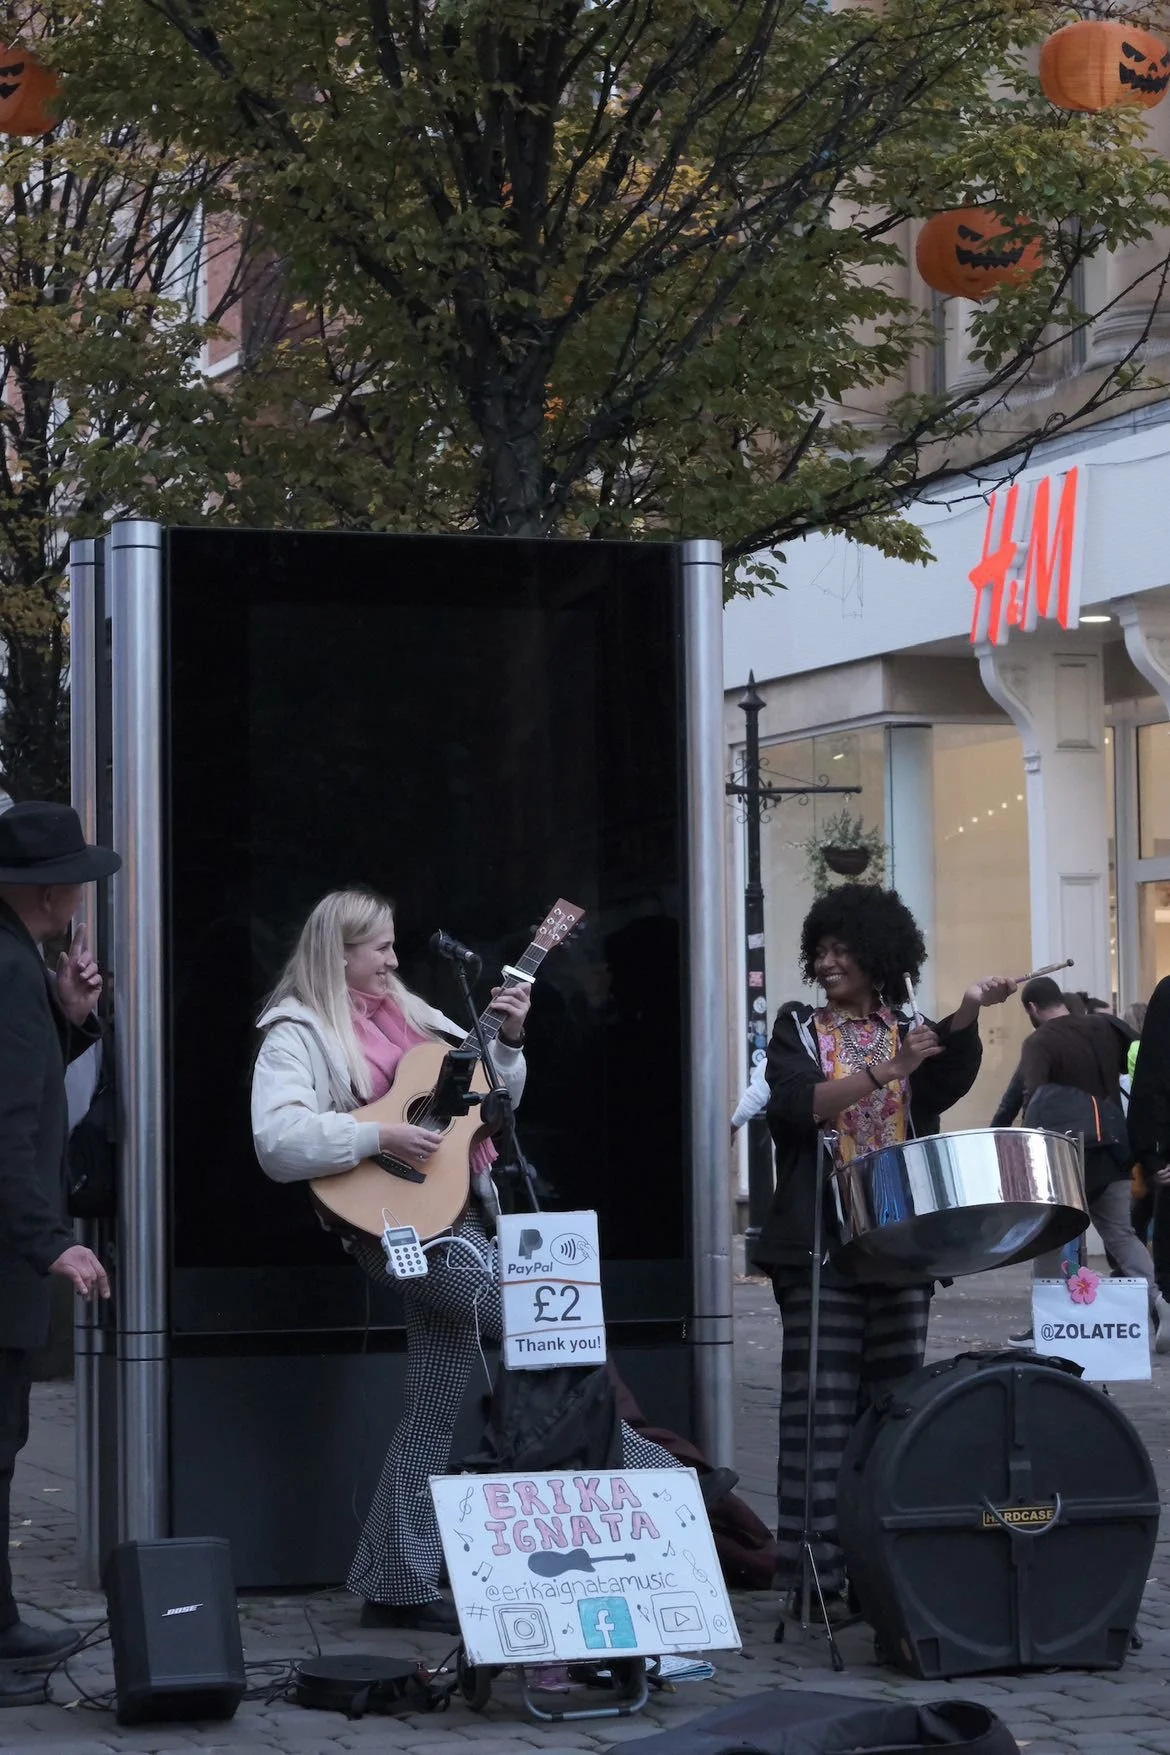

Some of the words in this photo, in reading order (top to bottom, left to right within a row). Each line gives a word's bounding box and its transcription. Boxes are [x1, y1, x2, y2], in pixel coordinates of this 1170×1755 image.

[968, 465, 1079, 648] H&M
[507, 1262, 553, 1276] PayPal
[533, 1285, 582, 1322] £2
[515, 1337, 565, 1352] Thank
[570, 1336, 601, 1353] you!
[1041, 1323, 1141, 1341] @ZOLATEC
[482, 1477, 642, 1519] ERIKA
[986, 1510, 1054, 1523] HRDCASE
[485, 1511, 660, 1556] IGNATA
[485, 1572, 678, 1604] @erikaignatamusic
